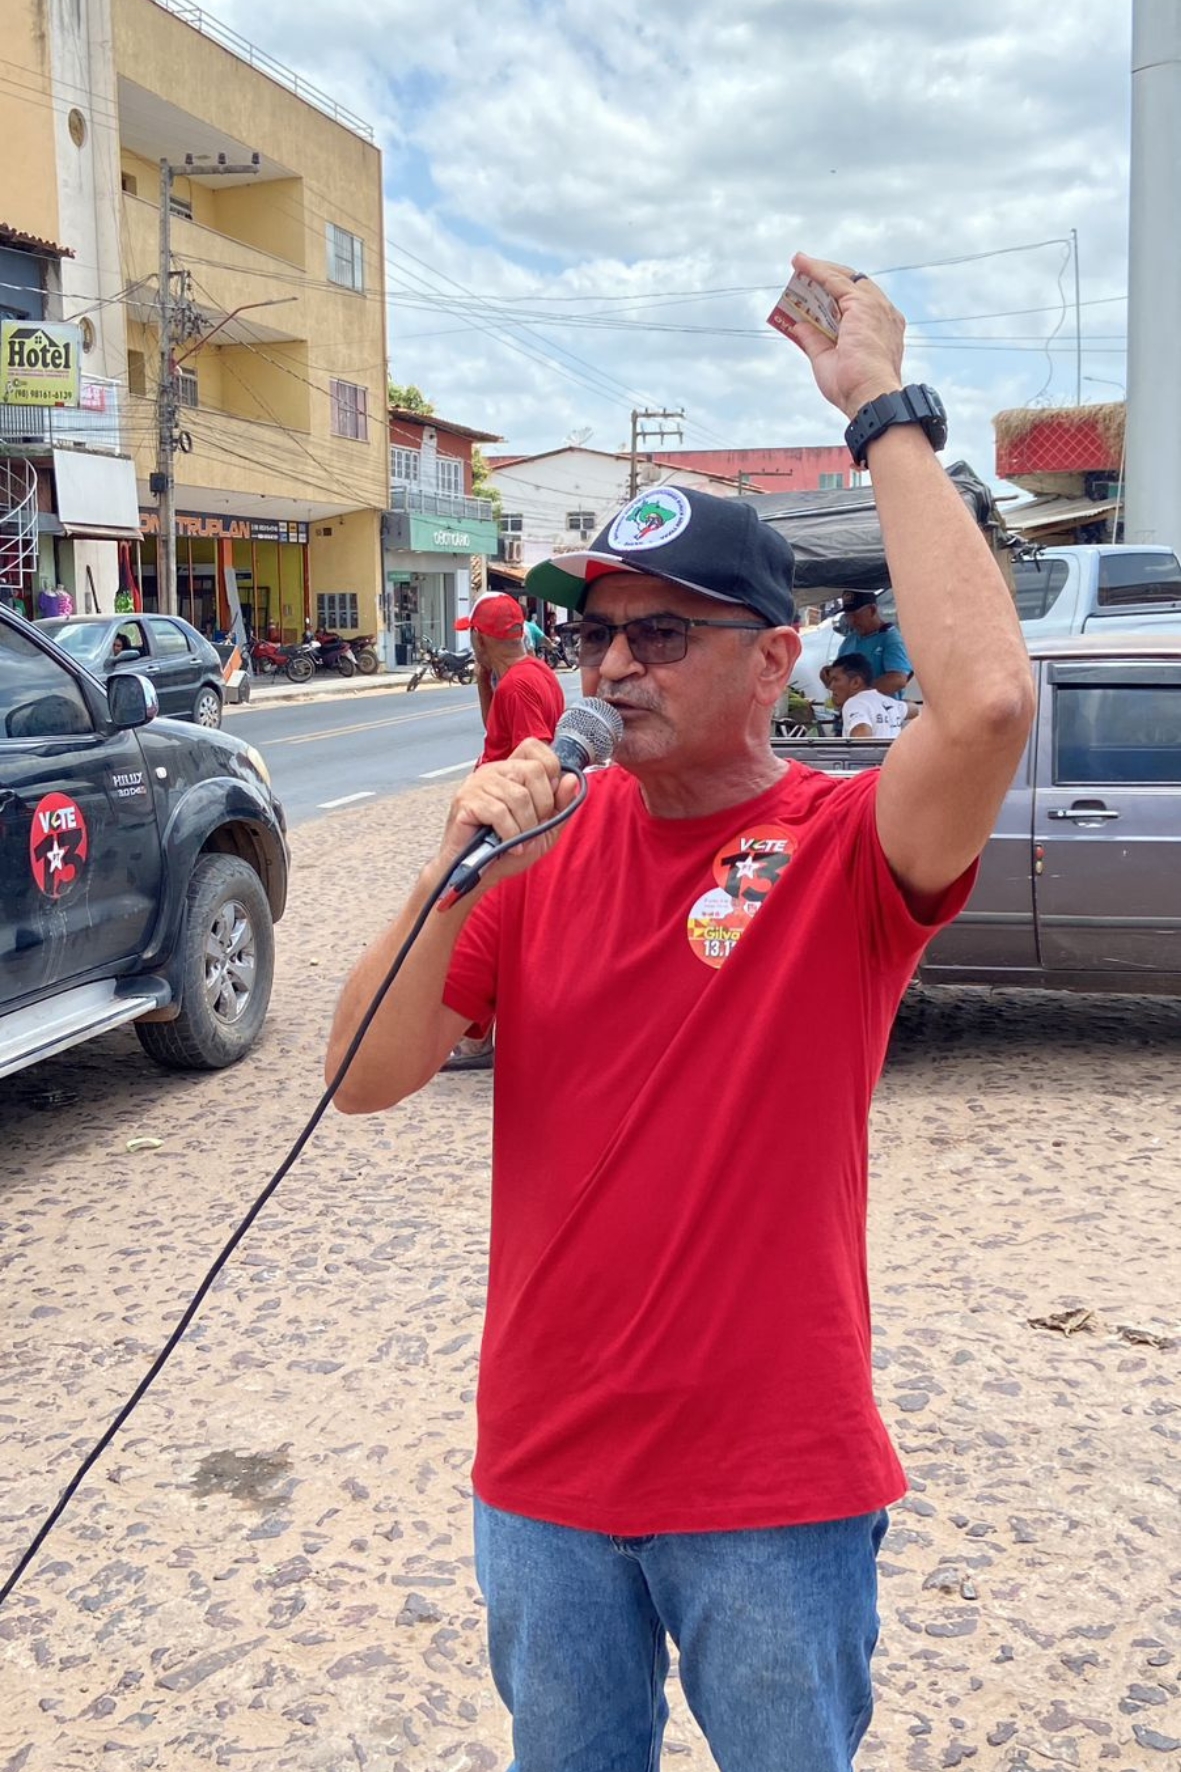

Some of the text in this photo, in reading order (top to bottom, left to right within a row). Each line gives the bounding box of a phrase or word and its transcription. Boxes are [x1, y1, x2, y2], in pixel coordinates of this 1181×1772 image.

[8, 340, 71, 369] Hotel
[113, 772, 142, 788] HILUX
[38, 806, 77, 833] VOTE
[740, 838, 789, 852] VOTE
[34, 829, 84, 896] 13
[721, 851, 792, 902] 13
